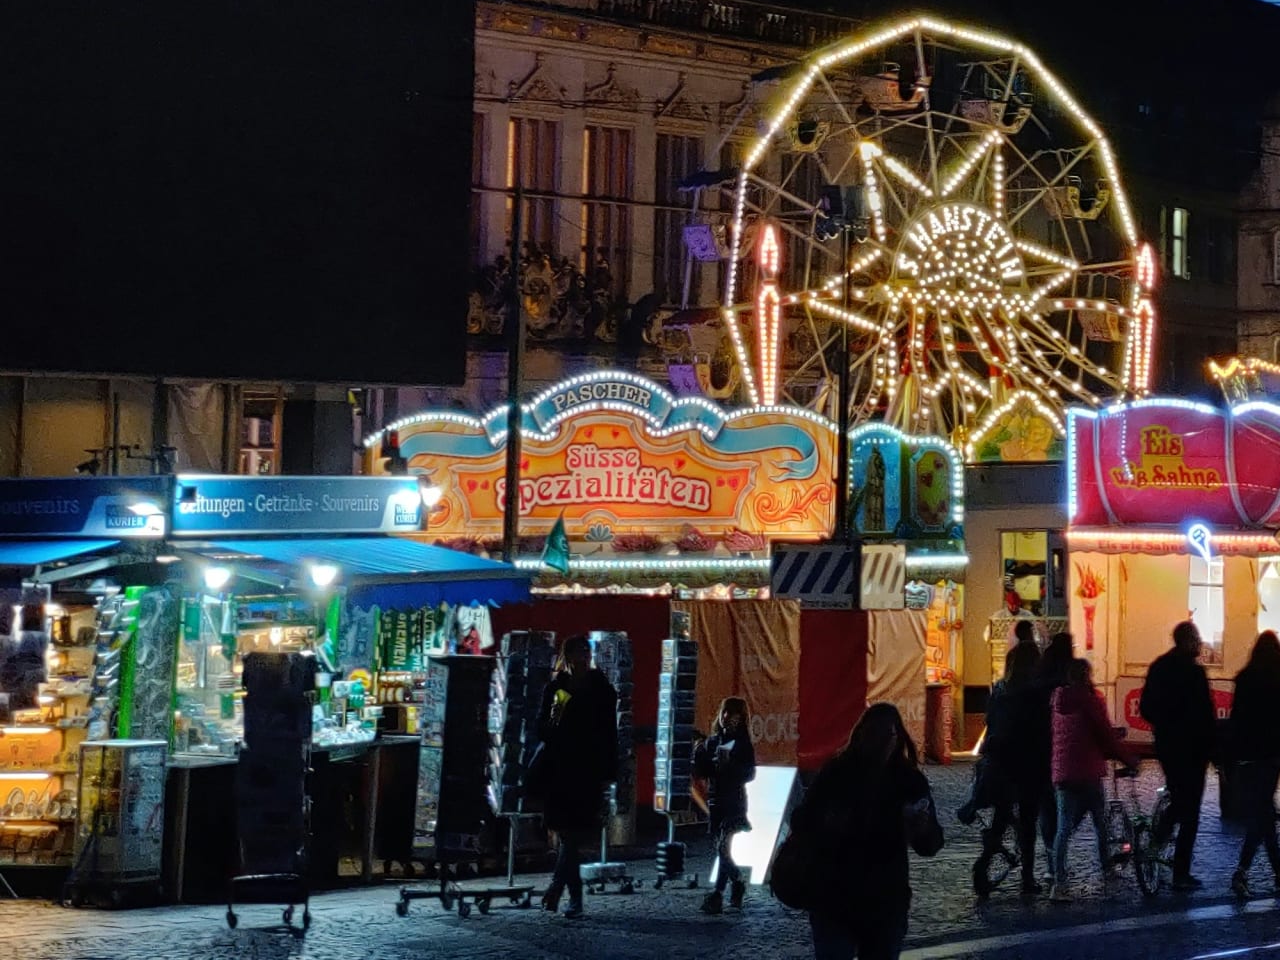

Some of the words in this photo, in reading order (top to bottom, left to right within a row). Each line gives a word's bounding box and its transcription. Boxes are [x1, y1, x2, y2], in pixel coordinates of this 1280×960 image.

[908, 205, 1023, 280] HANSTEIN
[552, 382, 651, 411] PASCHER
[1143, 428, 1182, 456] Eis
[567, 445, 640, 470] Süsse
[1112, 461, 1148, 488] wie
[1152, 464, 1220, 488] Sahne
[0, 495, 80, 515] ouvenirs
[256, 494, 313, 513] Getränke
[321, 494, 380, 513] Souvenirs
